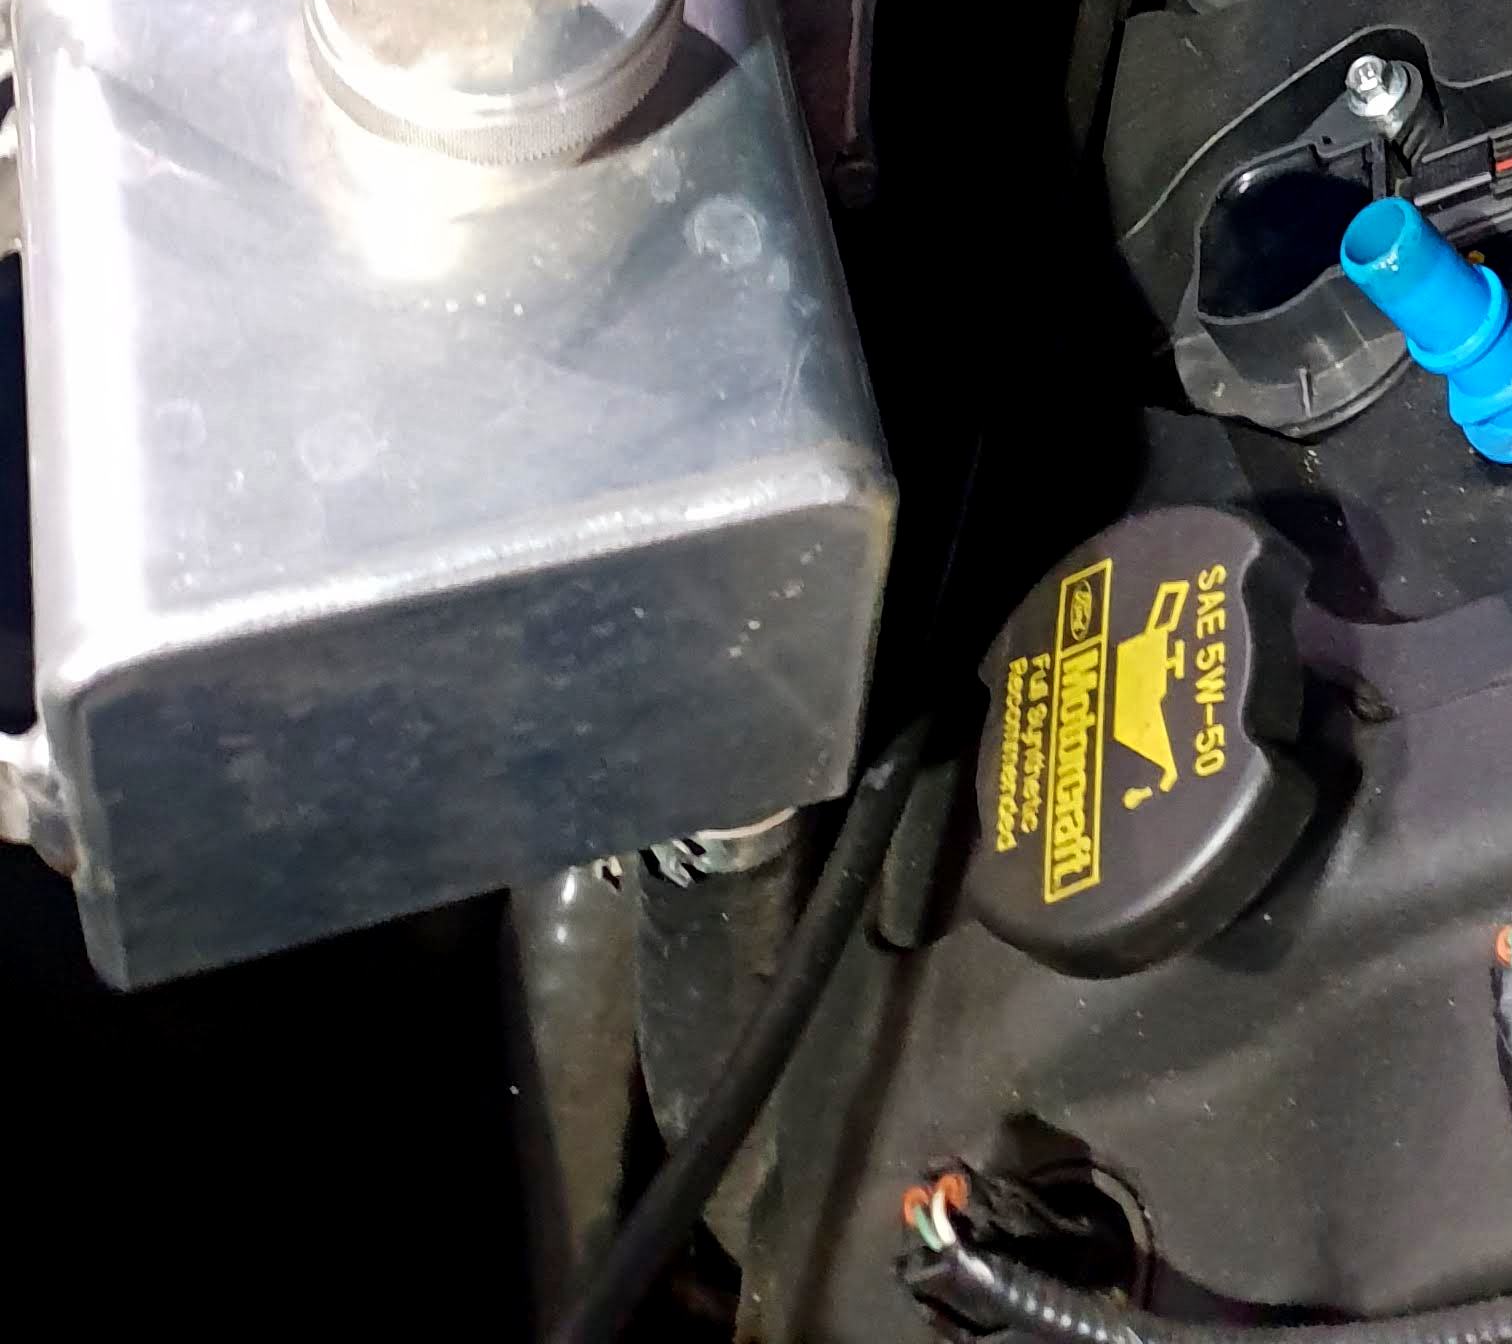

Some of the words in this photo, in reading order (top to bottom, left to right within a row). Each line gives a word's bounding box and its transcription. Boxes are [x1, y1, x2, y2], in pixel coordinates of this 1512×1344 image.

[1195, 563, 1228, 639] SAE
[1027, 652, 1051, 700] Full
[1193, 643, 1227, 778] 5W-50
[1052, 647, 1100, 886] Motorcraft
